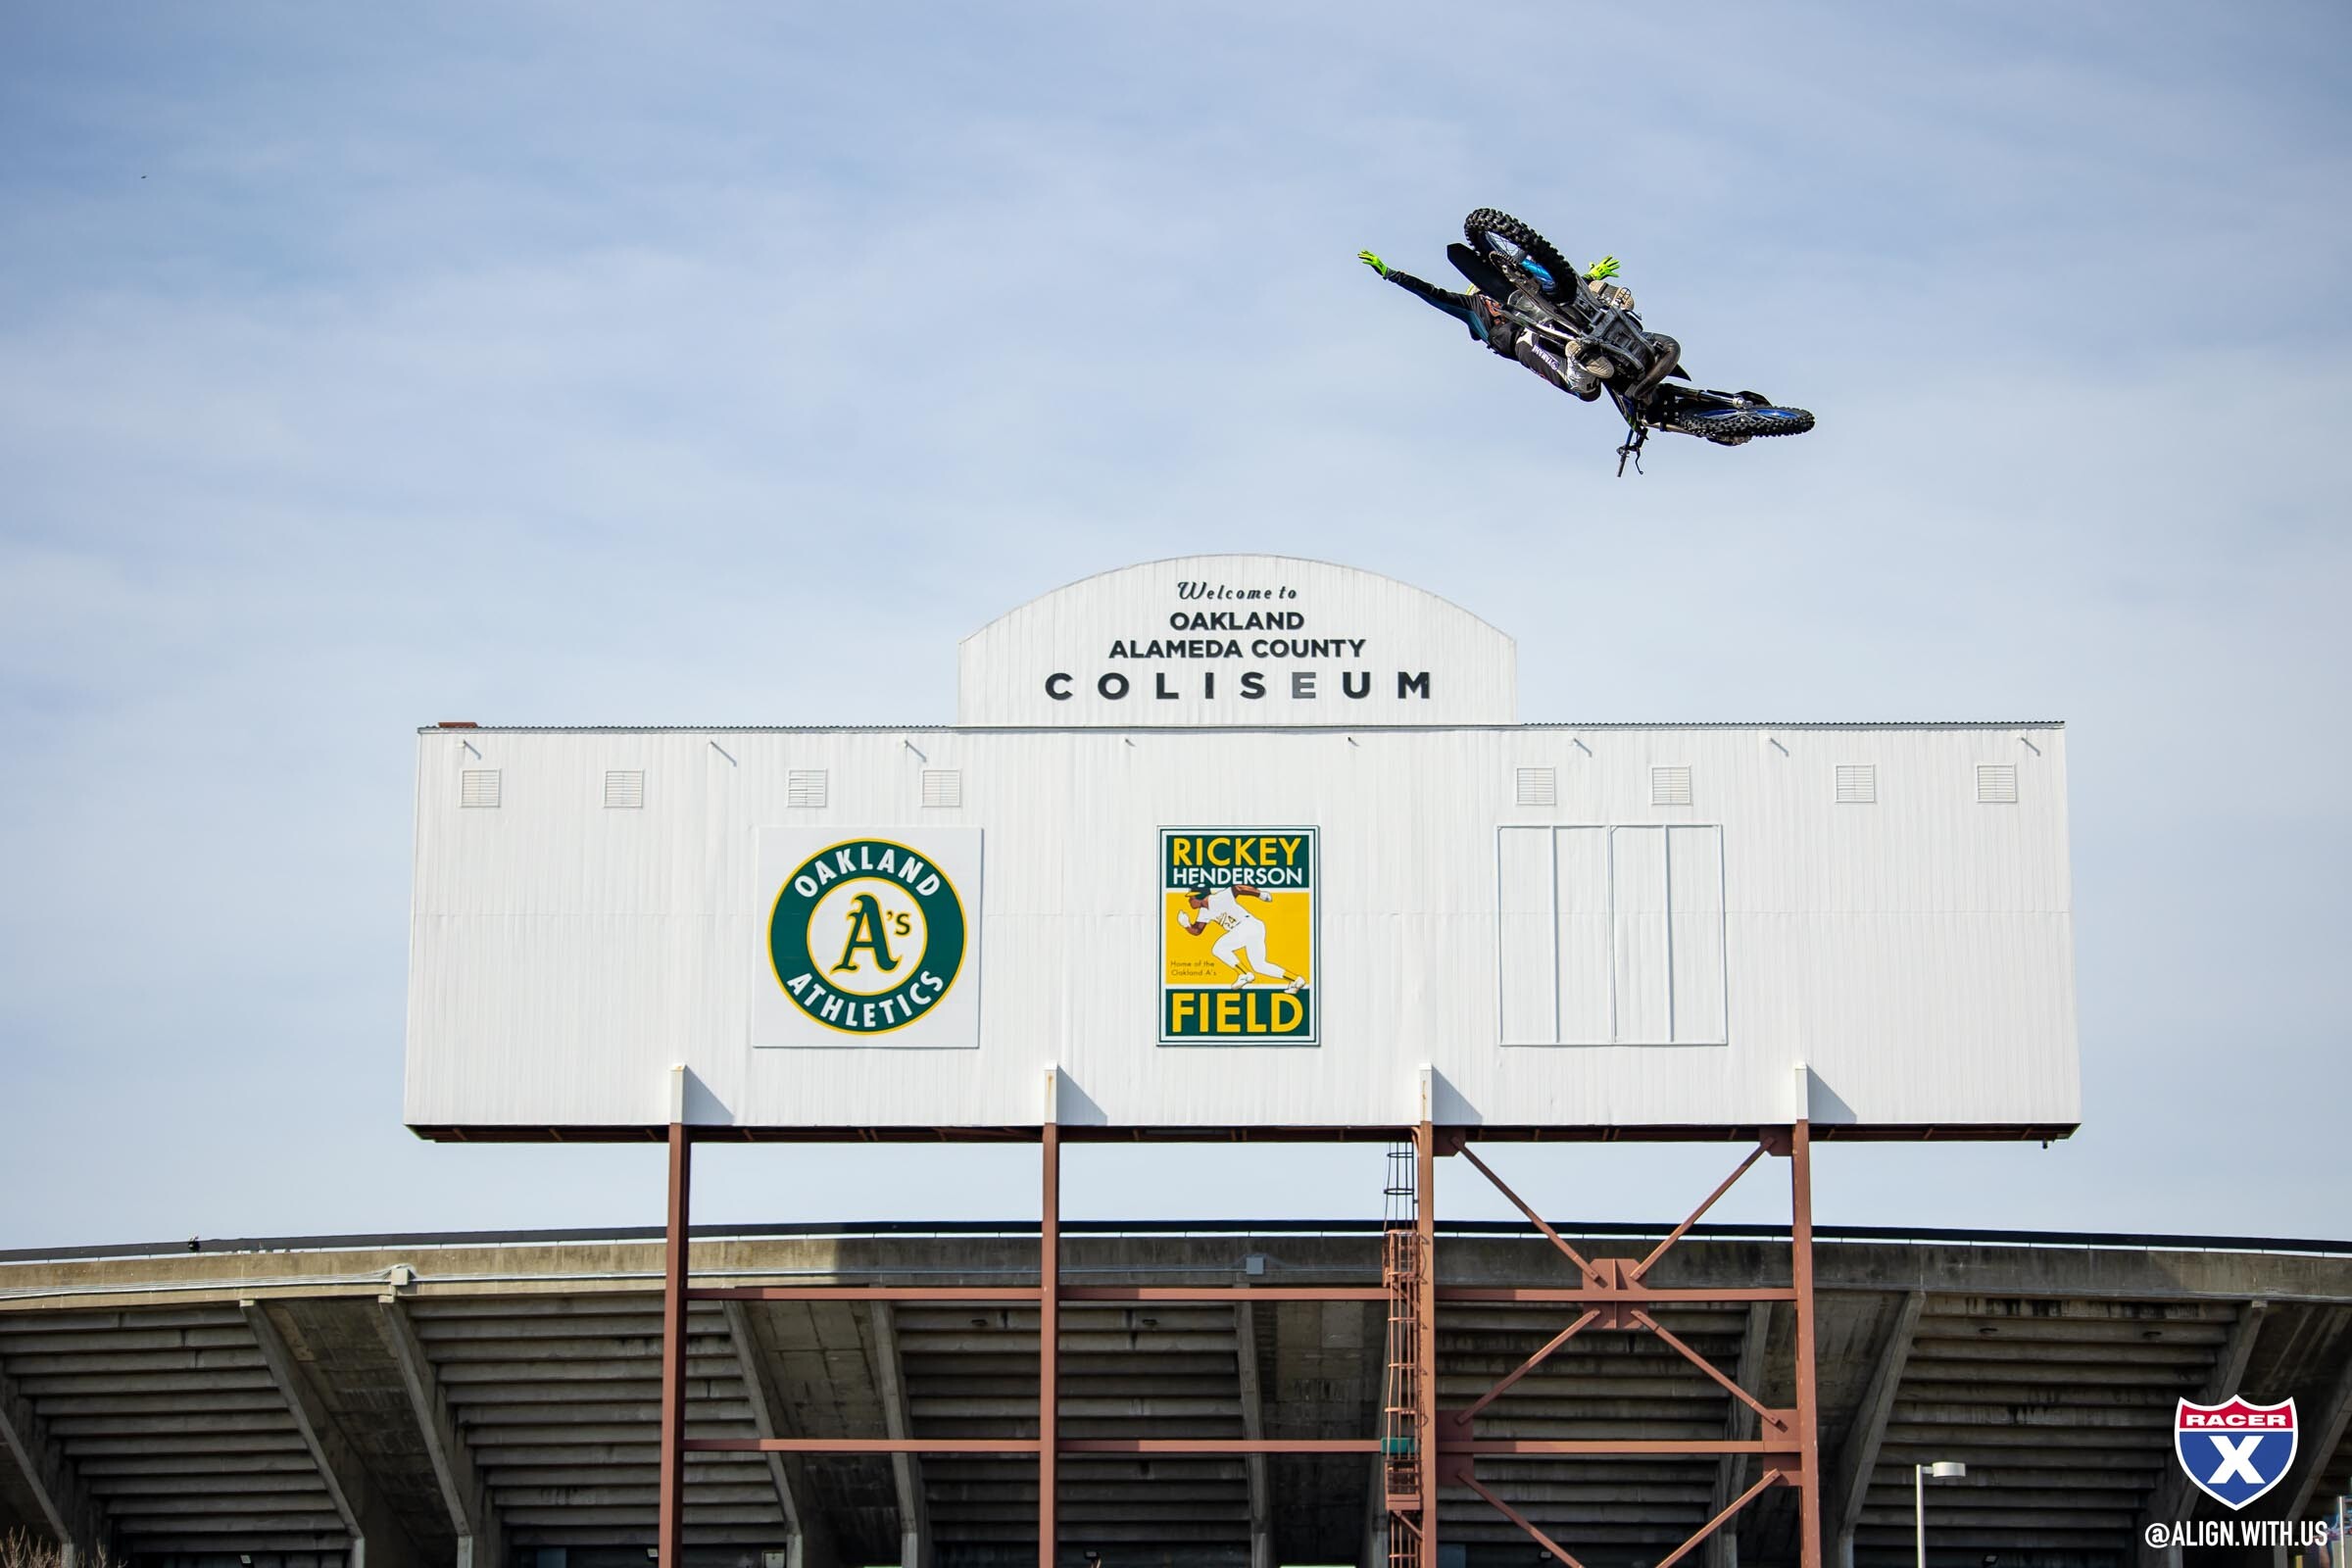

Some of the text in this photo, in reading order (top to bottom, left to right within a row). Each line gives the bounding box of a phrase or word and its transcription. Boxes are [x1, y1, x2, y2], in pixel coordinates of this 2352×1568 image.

[1177, 581, 1297, 600] Welcome to
[1170, 612, 1304, 630] OAKLAND
[1108, 639, 1367, 660] ALAMEDA COUNTY
[1045, 671, 1431, 700] COLISEUM
[1173, 838, 1301, 866] RICKEY
[794, 846, 941, 898] OAKLAND
[1173, 867, 1302, 885] HENDERSON
[787, 970, 944, 1027] ATHLETICS
[1172, 992, 1303, 1033] FIELD
